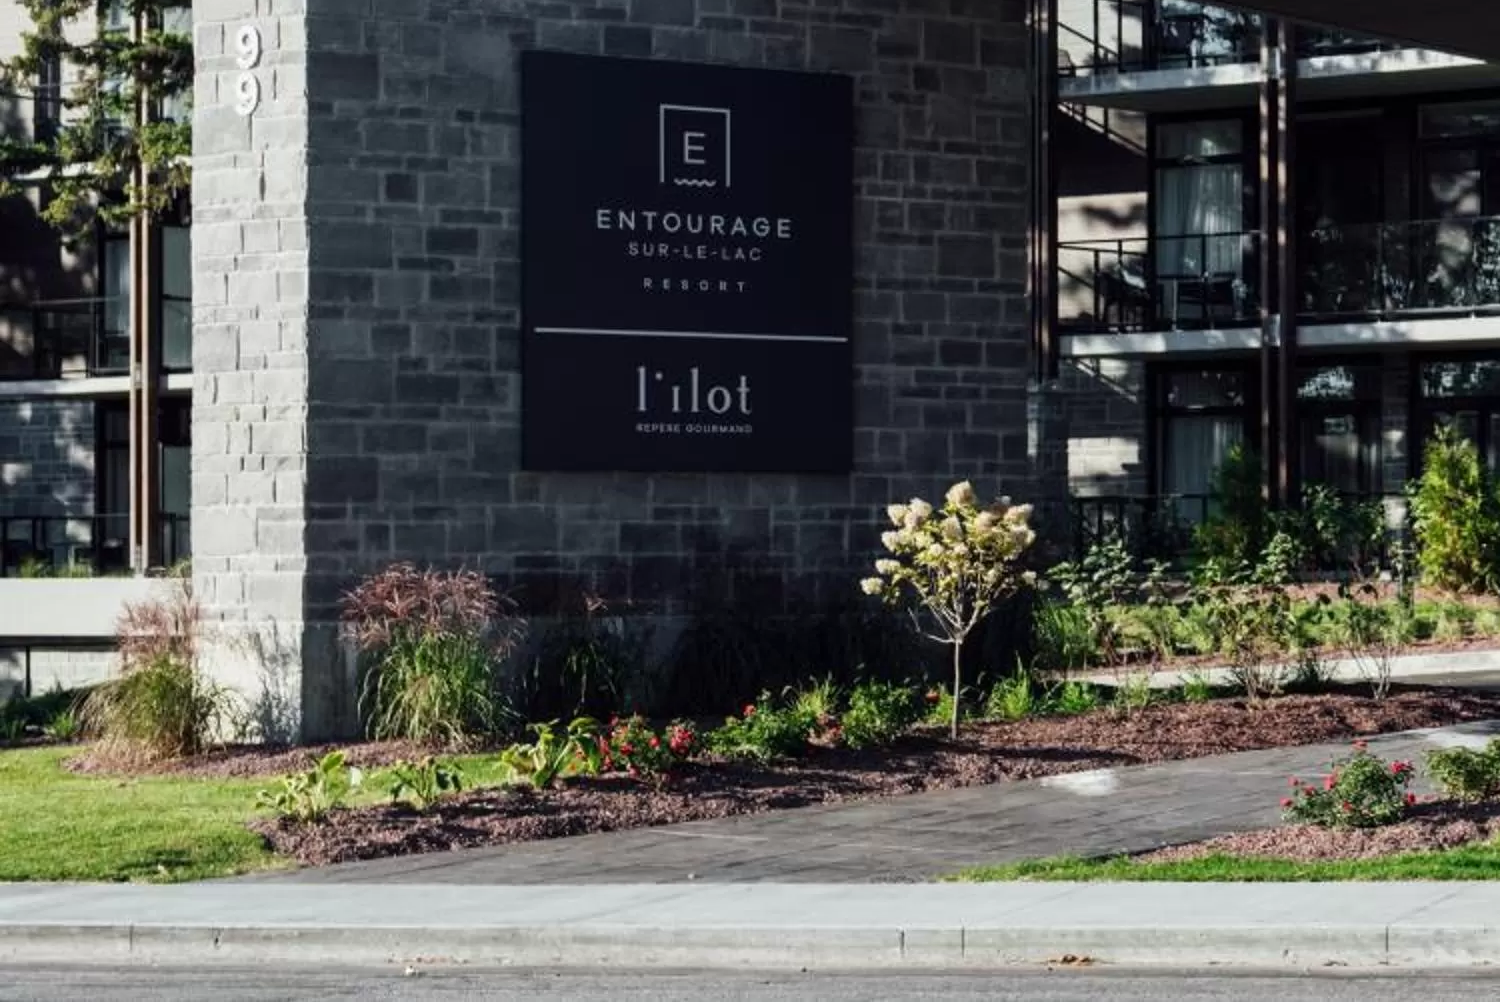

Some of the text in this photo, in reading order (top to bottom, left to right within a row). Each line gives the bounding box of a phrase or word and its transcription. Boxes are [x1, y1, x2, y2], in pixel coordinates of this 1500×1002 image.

[596, 209, 792, 238] ENTOURAGE
[628, 242, 762, 261] SUR-LE-LAC
[643, 277, 746, 292] RESORT
